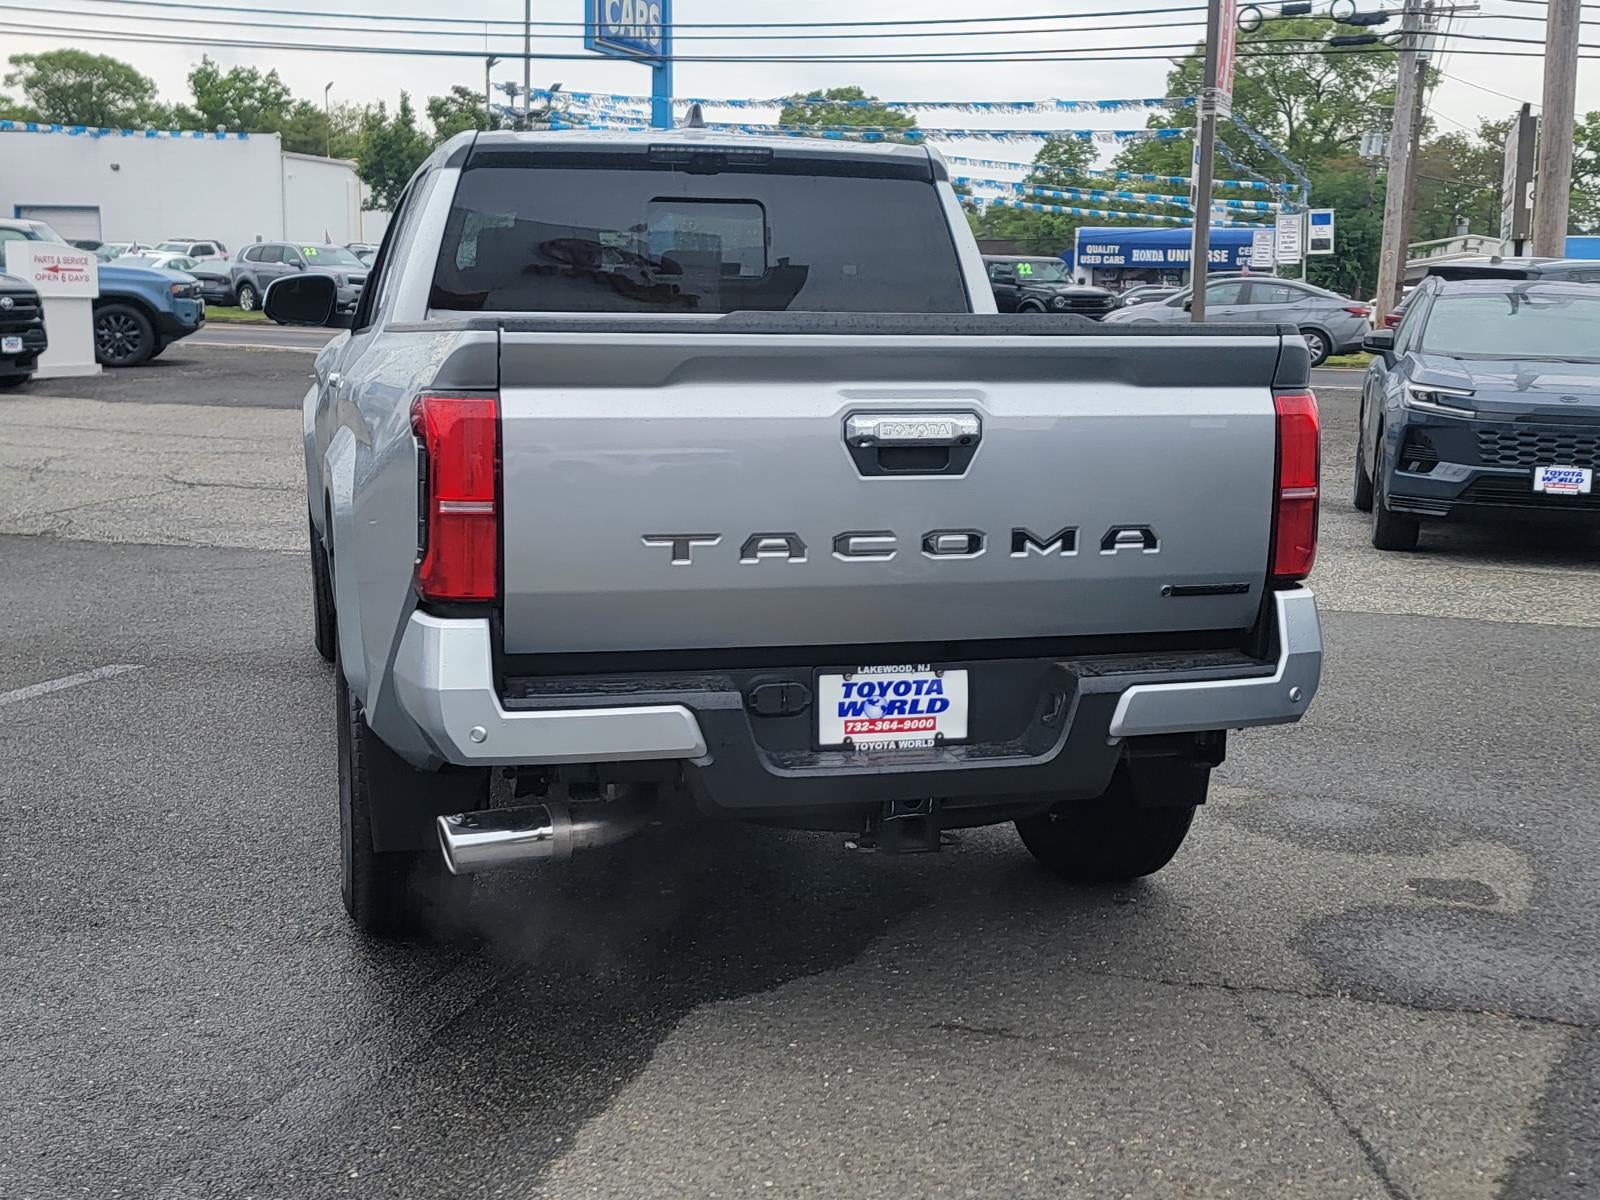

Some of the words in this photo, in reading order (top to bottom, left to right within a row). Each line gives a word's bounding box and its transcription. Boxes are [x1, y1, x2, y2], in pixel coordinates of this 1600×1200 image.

[605, 0, 660, 46] CARS
[1086, 245, 1119, 254] QUALITY
[1132, 249, 1164, 262] HONDA
[33, 255, 55, 264] PARTS
[56, 256, 61, 264] &
[62, 256, 89, 265] SERVICE
[1080, 255, 1101, 264] USED
[1103, 256, 1125, 265] CARS
[1017, 262, 1033, 274] 22
[35, 273, 58, 281] OPEN
[68, 274, 90, 282] DAYS
[882, 423, 950, 436] TOYOTA
[1543, 469, 1583, 478] TOYOTA
[640, 523, 1162, 566] TACOMA
[857, 664, 916, 674] LAKEWOOD,
[917, 663, 931, 673] NJ
[841, 678, 944, 699] TOYOTA
[846, 719, 934, 732] 732-364-9000
[854, 741, 897, 751] TOYOTA
[898, 739, 935, 750] WORLD
